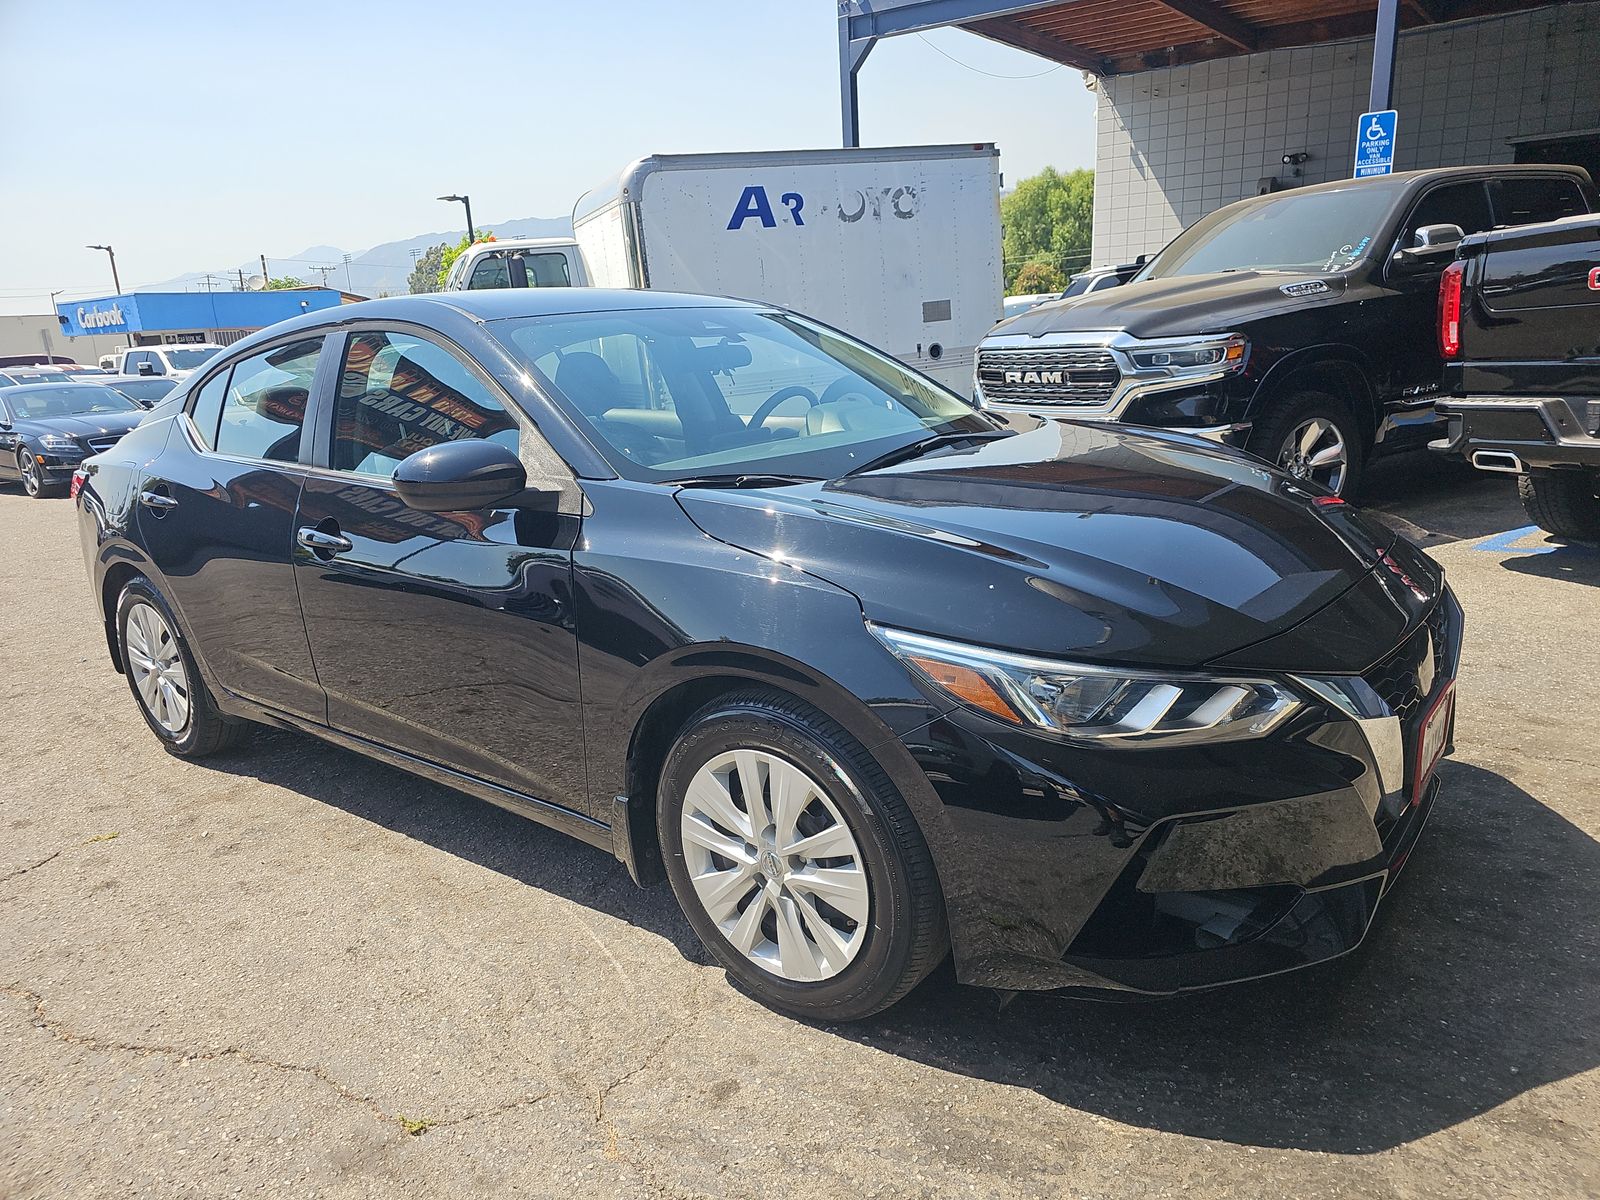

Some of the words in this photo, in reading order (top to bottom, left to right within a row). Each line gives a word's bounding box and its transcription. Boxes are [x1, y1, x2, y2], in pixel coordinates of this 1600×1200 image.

[1361, 139, 1390, 148] PARKING
[1366, 146, 1384, 154] ONLY
[1357, 156, 1391, 166] ACCESSIBLE
[1360, 166, 1386, 176] MINIMUM
[1005, 371, 1063, 384] RAM
